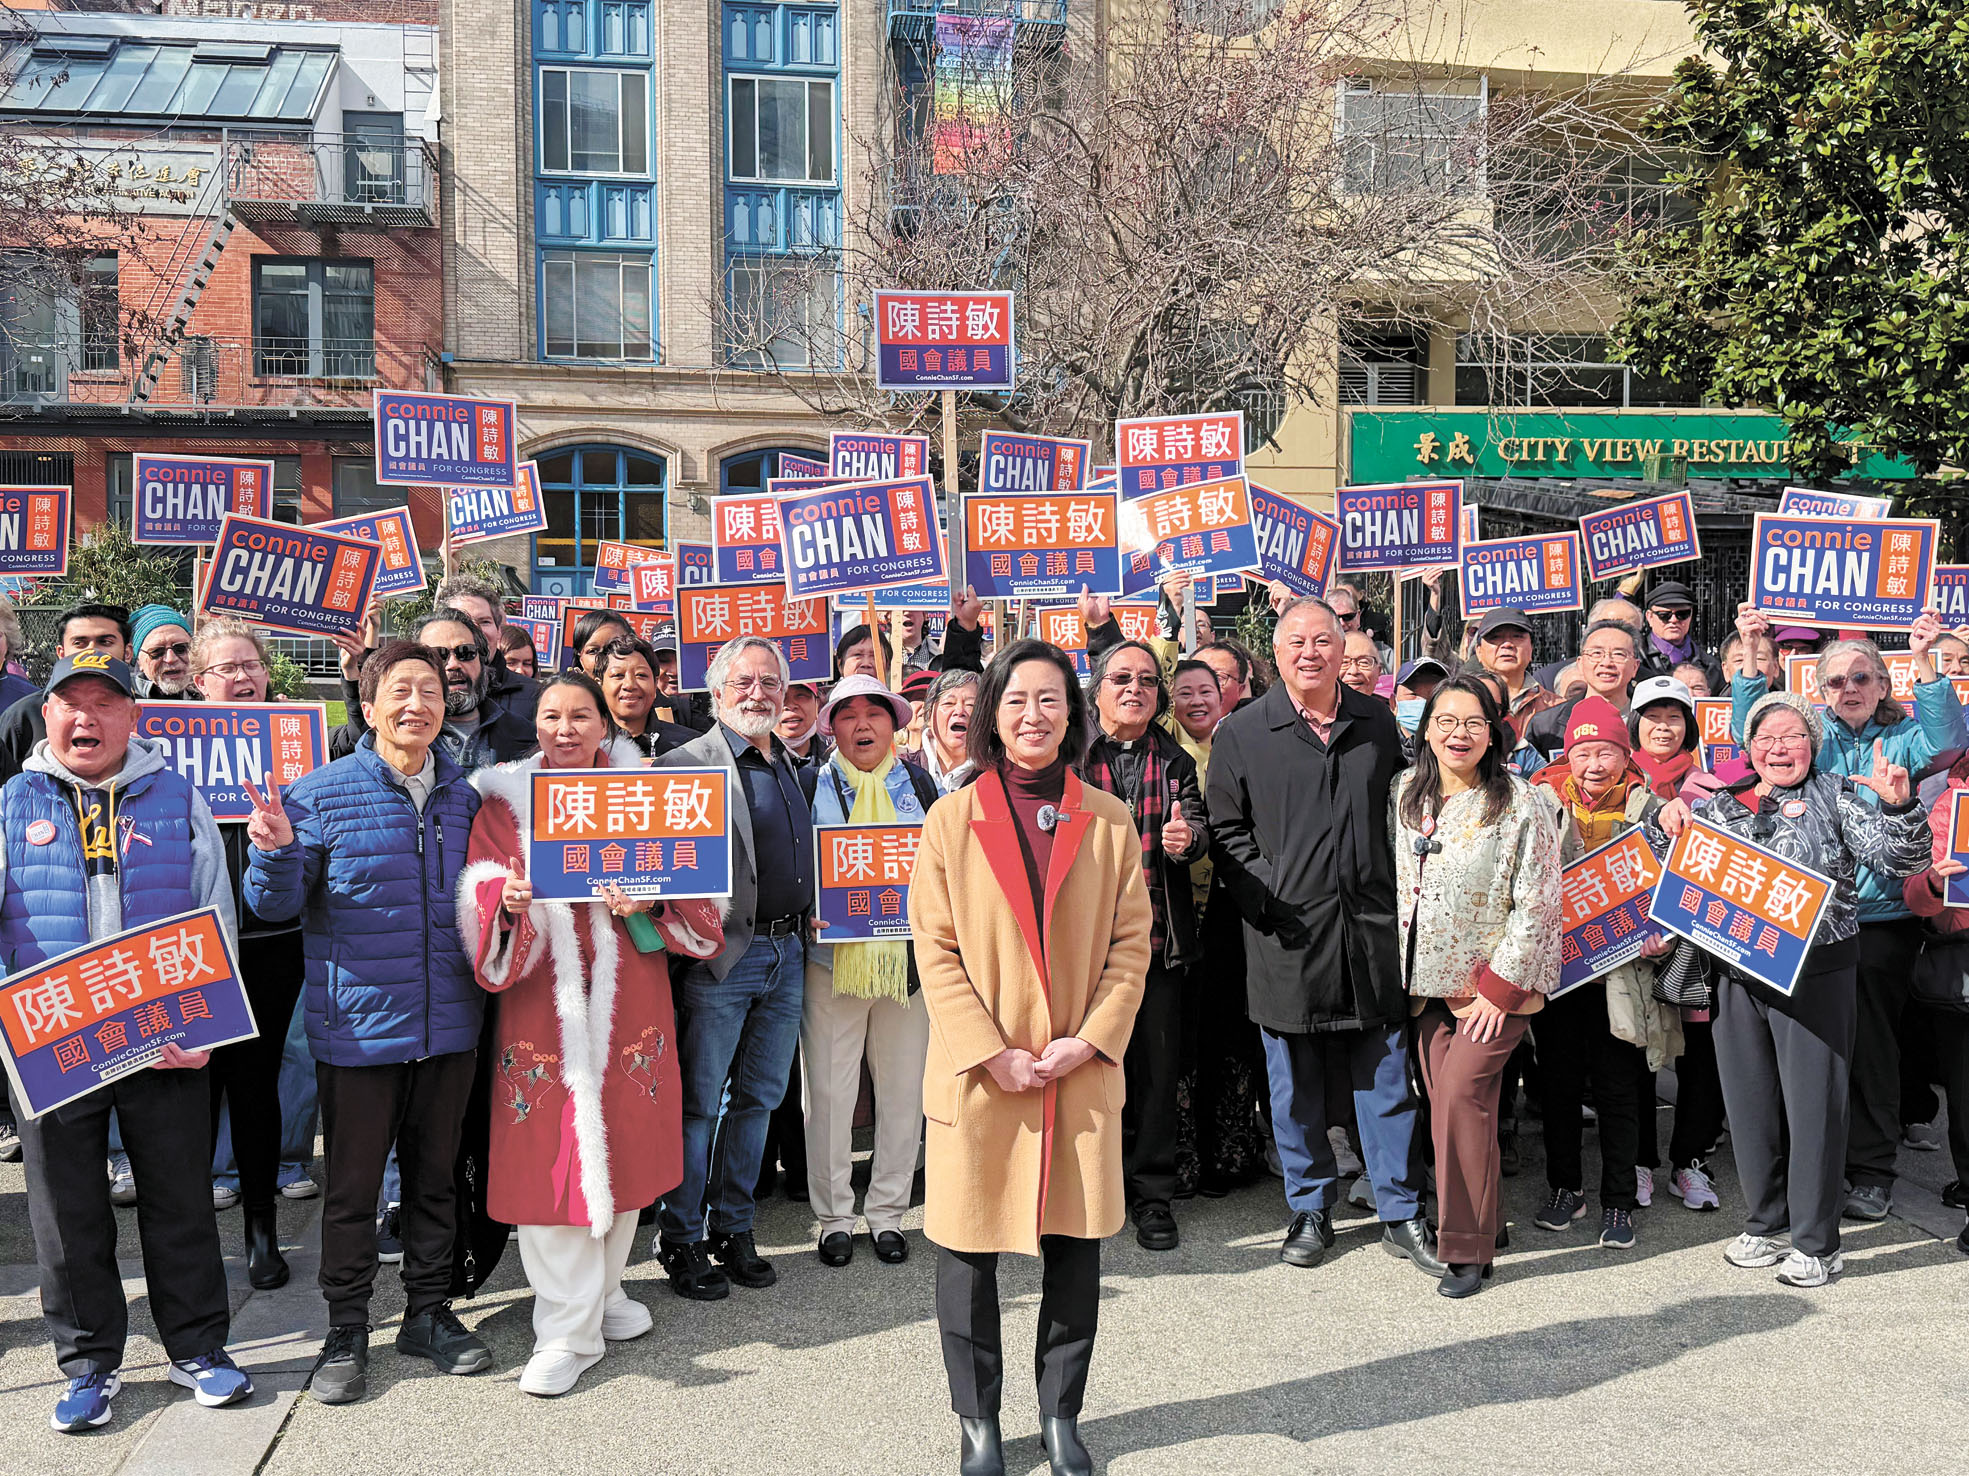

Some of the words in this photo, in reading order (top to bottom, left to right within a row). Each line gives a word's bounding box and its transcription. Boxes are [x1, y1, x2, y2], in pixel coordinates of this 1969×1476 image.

[888, 301, 1000, 340] 陳詩敏
[899, 349, 992, 372] 國會議員
[386, 402, 468, 422] connie
[387, 418, 470, 462] CHAN
[482, 409, 499, 461] 陳詩敏
[838, 439, 895, 453] connie
[991, 442, 1050, 459] connie
[1128, 421, 1232, 462] 陳詩敏
[1413, 431, 1474, 464] 景成
[1498, 438, 1572, 462] CITY
[1580, 438, 1661, 462] VIEW
[1672, 439, 1860, 464] RESTAUT
[145, 465, 226, 483] connie
[433, 464, 452, 472] FOR
[455, 465, 507, 475] CONGRESS
[784, 459, 820, 476] connie
[837, 451, 895, 480] CHAN
[989, 455, 1049, 491] CHAN
[1058, 448, 1074, 491] 陳詩敏
[1139, 466, 1223, 489] 國會議員
[145, 482, 226, 520] CHAN
[238, 471, 255, 516] 陳詩敏
[450, 489, 509, 526] CHAN
[789, 491, 881, 525] connie
[1344, 490, 1418, 512] connie
[1789, 497, 1849, 515] connie
[34, 498, 51, 547] 陳詩敏
[499, 514, 537, 526] CONGRESS
[724, 504, 780, 542] 陳詩
[896, 491, 922, 551] 陳詩敏
[977, 501, 1106, 545] 陳詩敏
[1137, 487, 1239, 537] 詩敏
[1251, 496, 1307, 531] onnie
[1345, 508, 1418, 548] CHAN
[1431, 492, 1446, 540] 陳詩敏
[1590, 508, 1653, 534] connie
[232, 530, 328, 562] connie
[382, 521, 405, 566] 陳詩敏
[792, 513, 888, 569] CHAN
[1131, 531, 1232, 574] 國會議員
[1255, 514, 1304, 569] HAN
[1405, 547, 1452, 556] CONGRESS
[1466, 543, 1537, 565] connie
[1592, 520, 1658, 561] CHAN
[1646, 544, 1689, 557] CONGRESS
[1766, 526, 1872, 550] connie
[219, 548, 324, 605] CHAN
[375, 571, 414, 583] ONGRESS
[736, 548, 777, 571] 國會
[753, 572, 785, 580] ConnieCha
[847, 567, 870, 575] FOR
[874, 557, 933, 573] CONGRESS
[991, 551, 1096, 577] 國會議員
[1265, 562, 1281, 574] FOR
[1284, 570, 1319, 593] CONGRESS
[1468, 559, 1539, 596] CHAN
[1549, 543, 1564, 586] 陳詩敏
[1763, 546, 1870, 598] CHAN
[1886, 533, 1911, 596] 陳詩敏
[332, 549, 362, 609] 陳詩敏
[1525, 591, 1571, 602] CONGRESS
[265, 603, 288, 615] FOR
[291, 608, 352, 626] CONGRESS
[527, 605, 555, 619] CHAN
[692, 591, 817, 638] 陳詩敏
[1815, 600, 1840, 611] FOR
[1844, 602, 1913, 613] CONGRESS
[1852, 613, 1913, 622] ConnieChanSF.com
[1050, 611, 1150, 646] 陳敏
[145, 711, 261, 736] connie
[1573, 724, 1598, 740] USC
[279, 717, 304, 781] 陳詩敏
[210, 792, 237, 802] FOR
[548, 779, 713, 835] 陳詩敏
[563, 841, 699, 874] 國會議員
[832, 833, 921, 882] 陳詩
[1563, 844, 1654, 923] 詩敏
[1679, 830, 1813, 929] 陳詩敏
[848, 888, 902, 916] 國會
[868, 918, 910, 926] ConnieCha
[1561, 894, 1651, 965] 國會議員
[1679, 884, 1780, 959] 國會議員
[1691, 919, 1752, 957] ConnieChanSF.com
[1584, 929, 1648, 965] ConnieChanSF.com
[11, 927, 216, 1045] 陳詩敏
[52, 990, 214, 1075] 國會議員
[91, 1030, 186, 1073] ConnieChanSF.com
